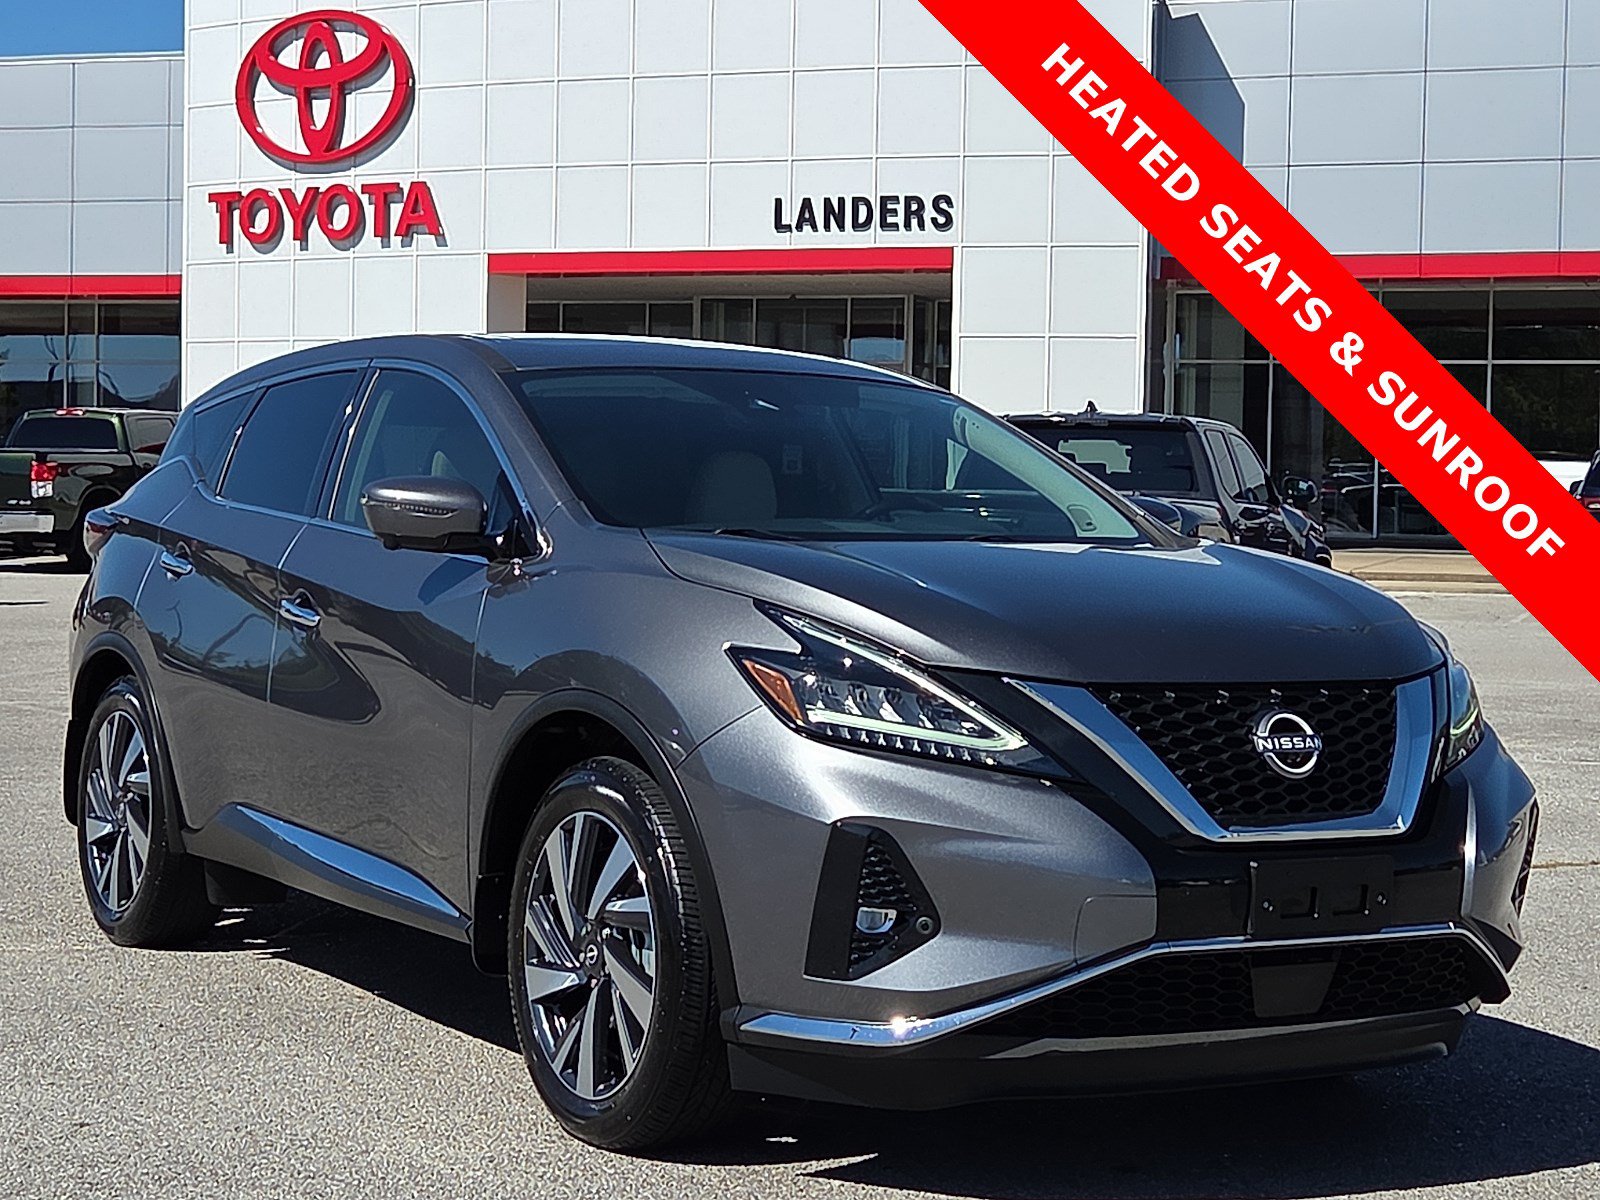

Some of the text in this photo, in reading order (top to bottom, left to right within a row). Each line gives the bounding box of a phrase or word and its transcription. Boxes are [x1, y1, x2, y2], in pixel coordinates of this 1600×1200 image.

[208, 182, 443, 247] TOYOTA
[774, 194, 954, 233] LANDERS
[1256, 736, 1321, 751] NISSAN
